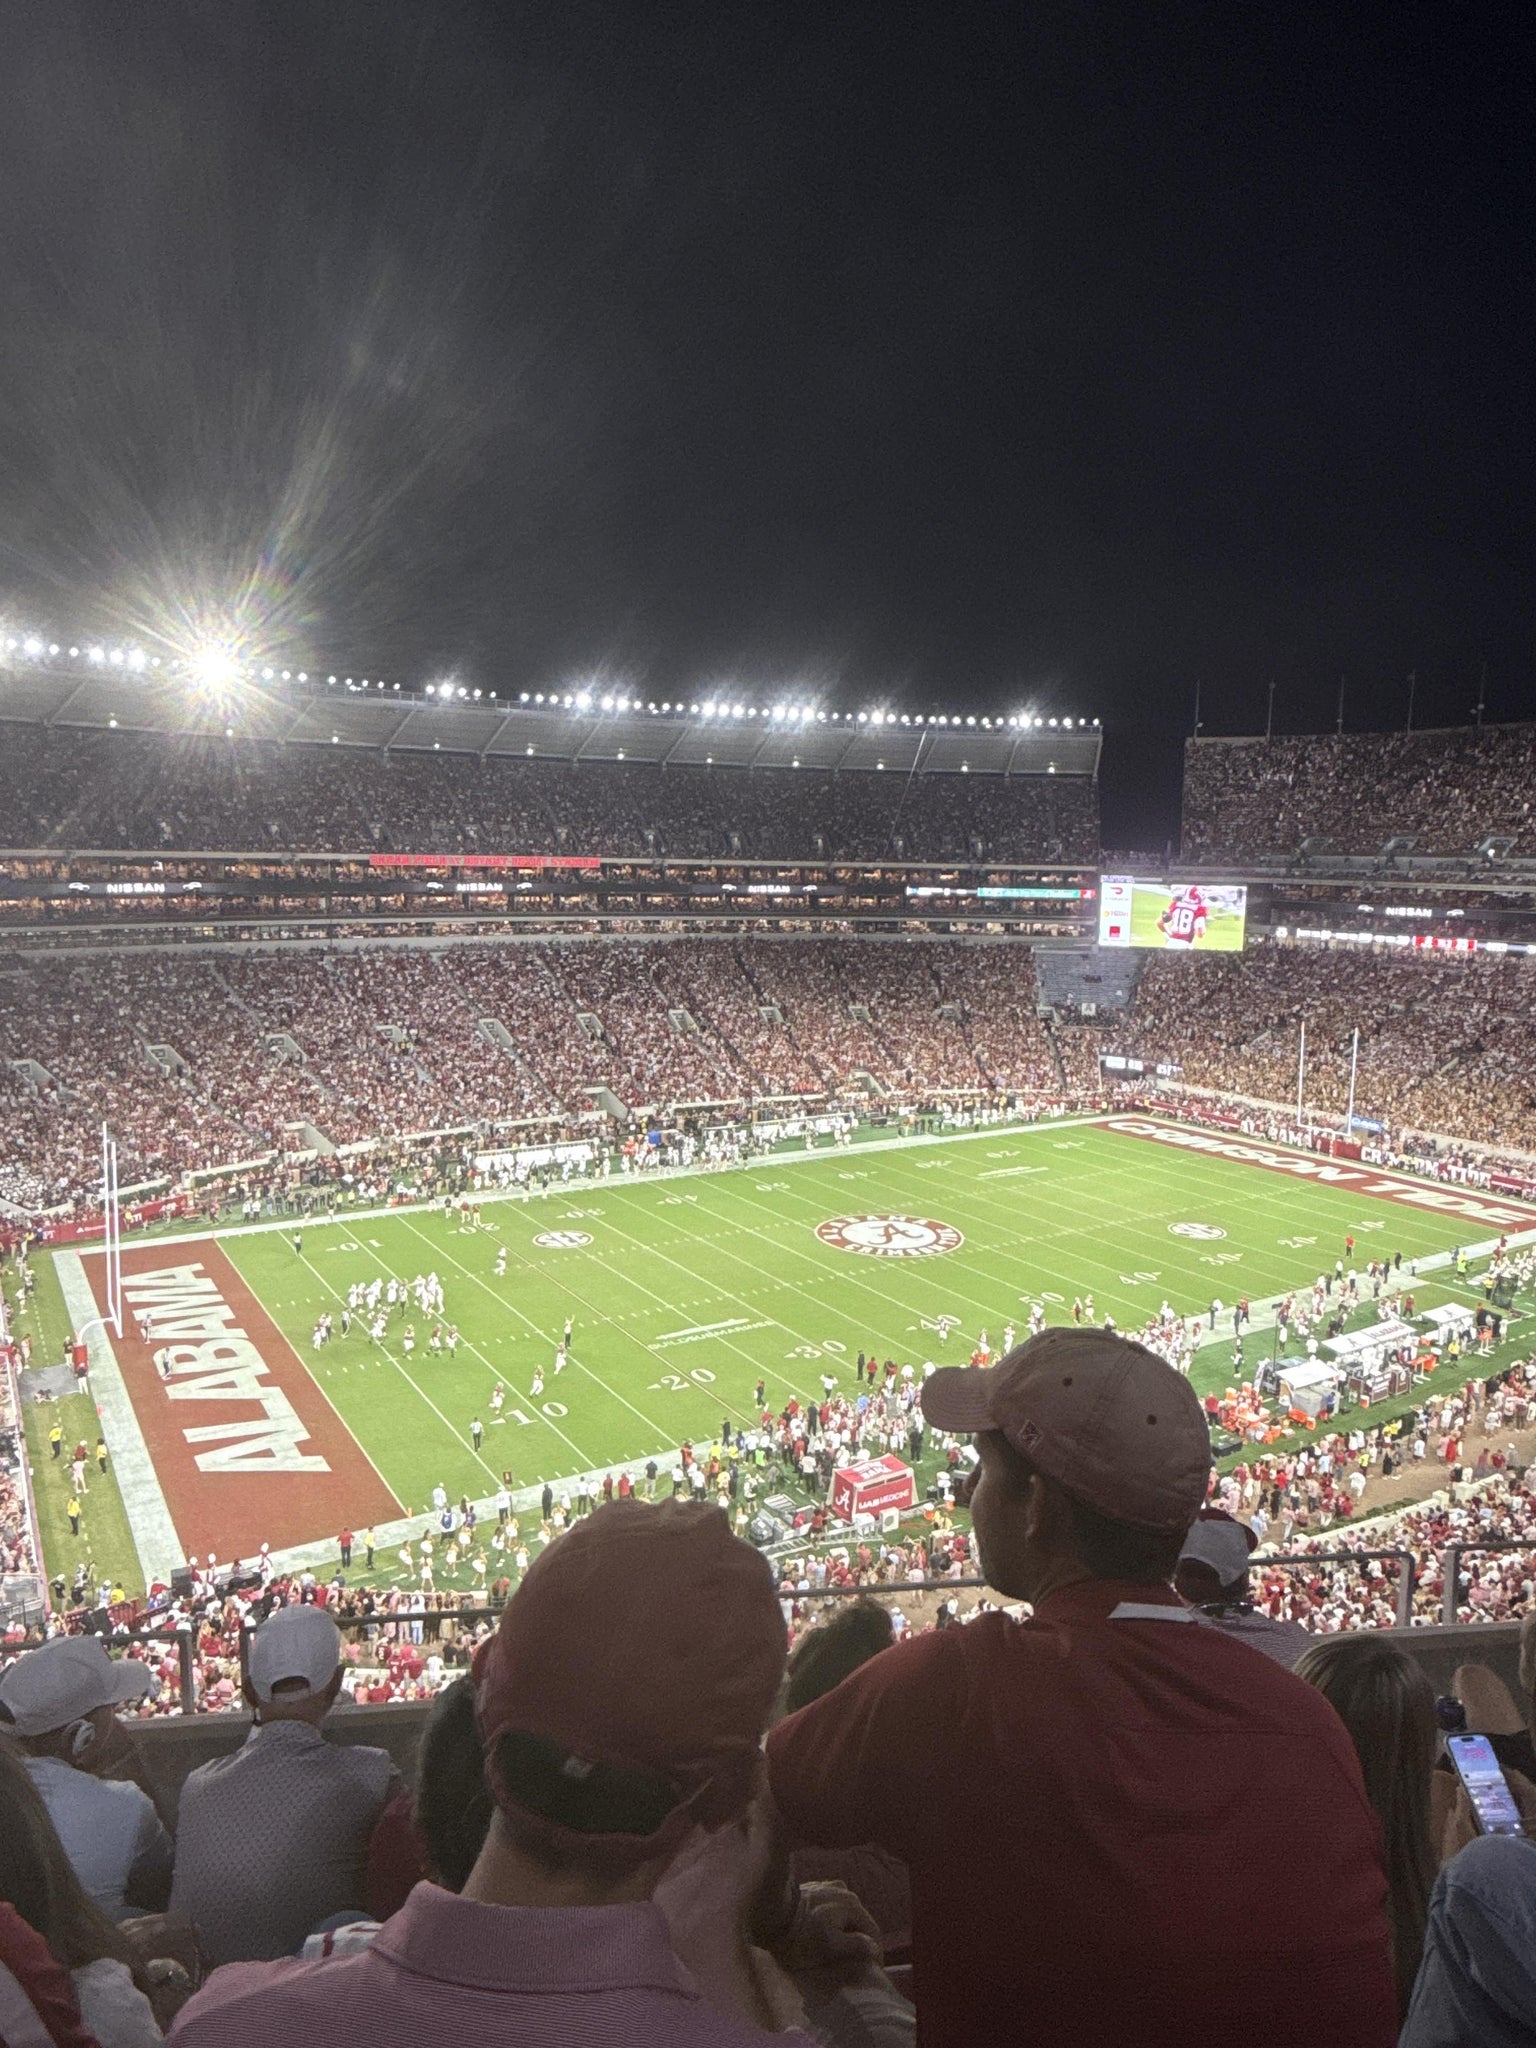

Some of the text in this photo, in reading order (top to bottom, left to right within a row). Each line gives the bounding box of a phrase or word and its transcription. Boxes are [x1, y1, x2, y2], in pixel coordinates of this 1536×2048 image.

[106, 882, 165, 893] NISSAN
[456, 882, 503, 893] NISSAN
[748, 884, 790, 893] NISSAN
[1385, 906, 1432, 917] NISSAN
[1107, 1121, 1536, 1225] CRIMSON TIDE
[536, 1230, 592, 1249] SEC
[795, 1340, 847, 1359] 30
[120, 1262, 332, 1472] ALABAMA
[660, 1368, 717, 1391] 20
[506, 1401, 569, 1426] 10
